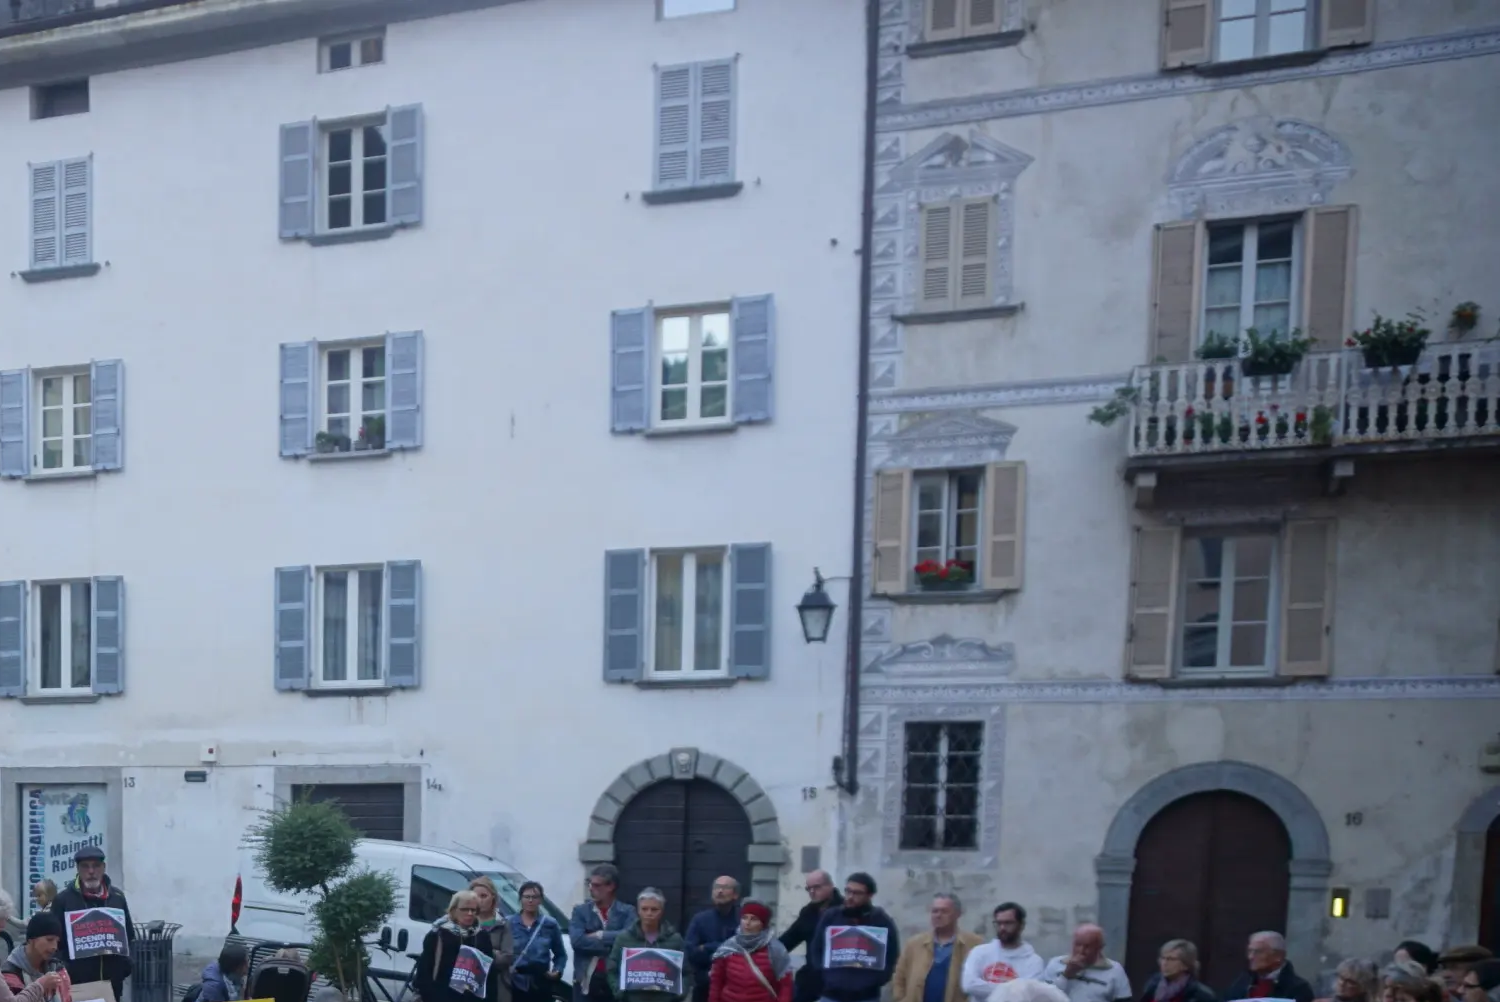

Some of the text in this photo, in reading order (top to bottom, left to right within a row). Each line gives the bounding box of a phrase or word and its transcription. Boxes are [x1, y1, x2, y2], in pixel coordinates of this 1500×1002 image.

[124, 777, 136, 788] 13
[802, 786, 817, 800] 15
[1345, 812, 1363, 826] 16
[50, 833, 103, 858] Mainetti
[75, 934, 105, 943] SCENDI
[76, 941, 105, 951] PIAZZA
